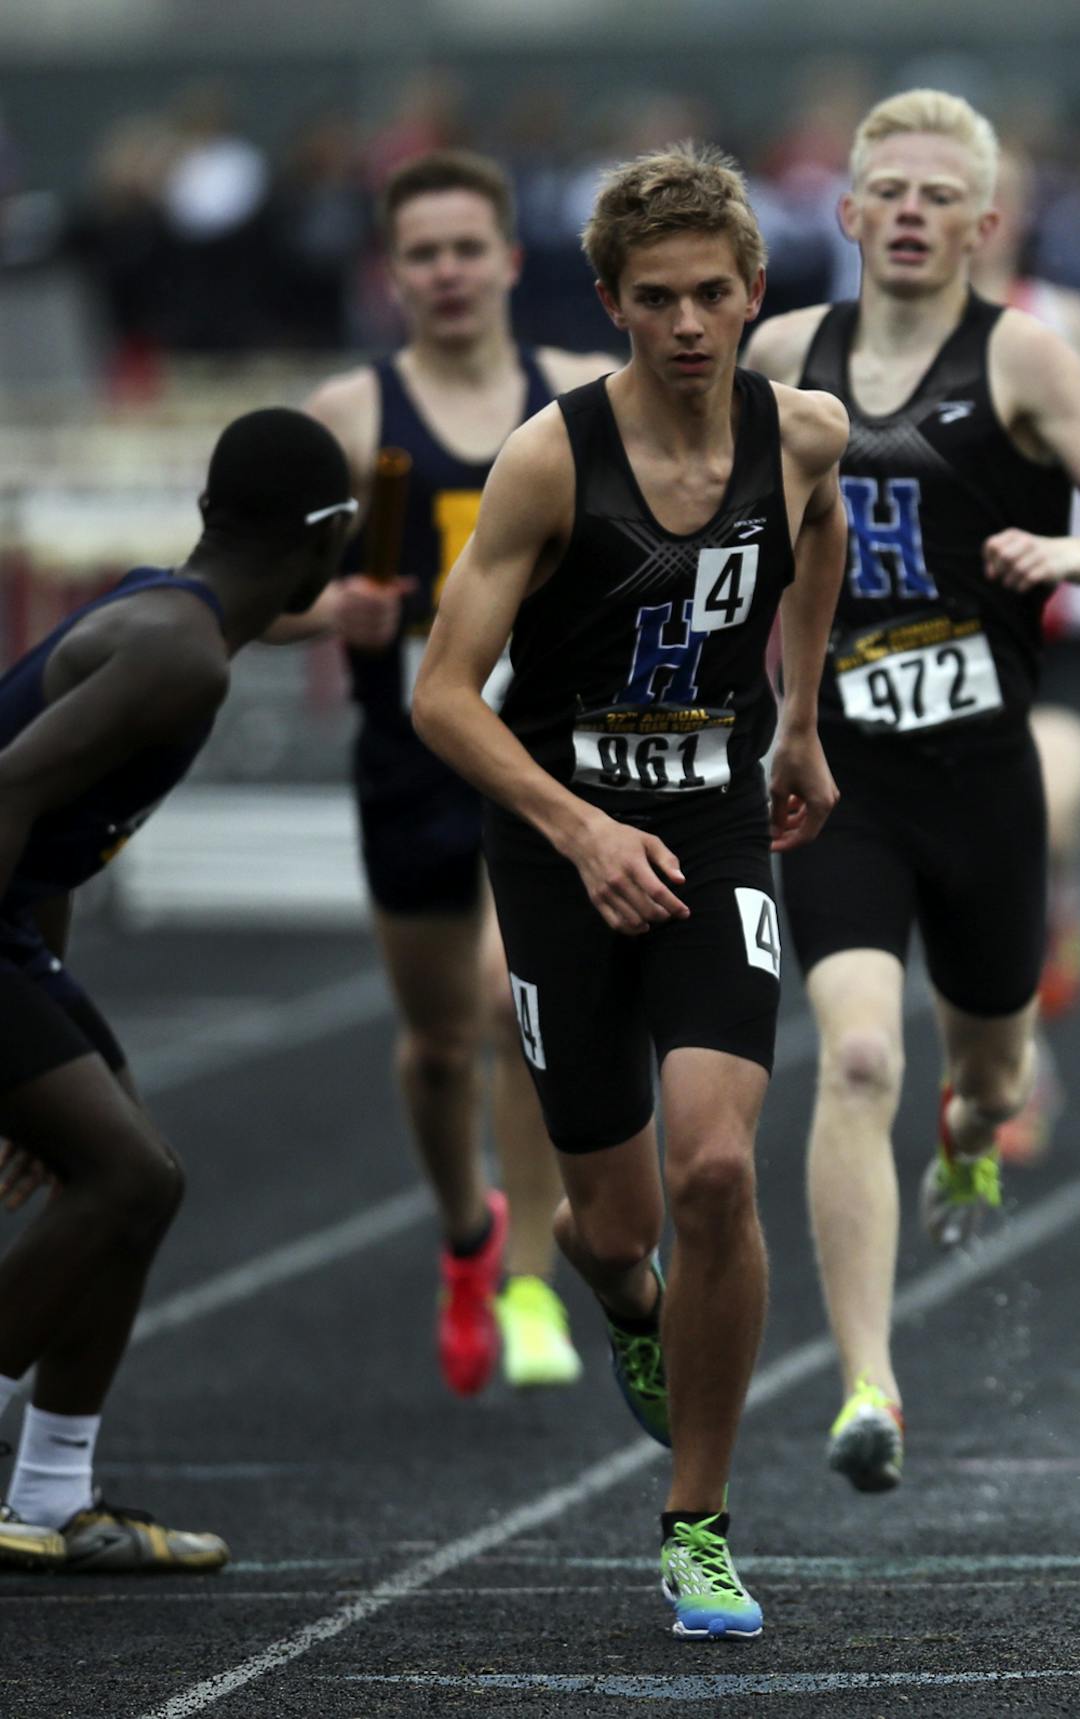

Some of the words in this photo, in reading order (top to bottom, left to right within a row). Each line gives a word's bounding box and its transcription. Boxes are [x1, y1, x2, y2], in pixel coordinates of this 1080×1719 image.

[840, 475, 939, 599] H
[705, 552, 744, 624] 4
[613, 599, 712, 705] H
[867, 647, 977, 725] 972
[598, 734, 706, 789] 961
[755, 900, 780, 970] 4
[519, 986, 537, 1060] 4
